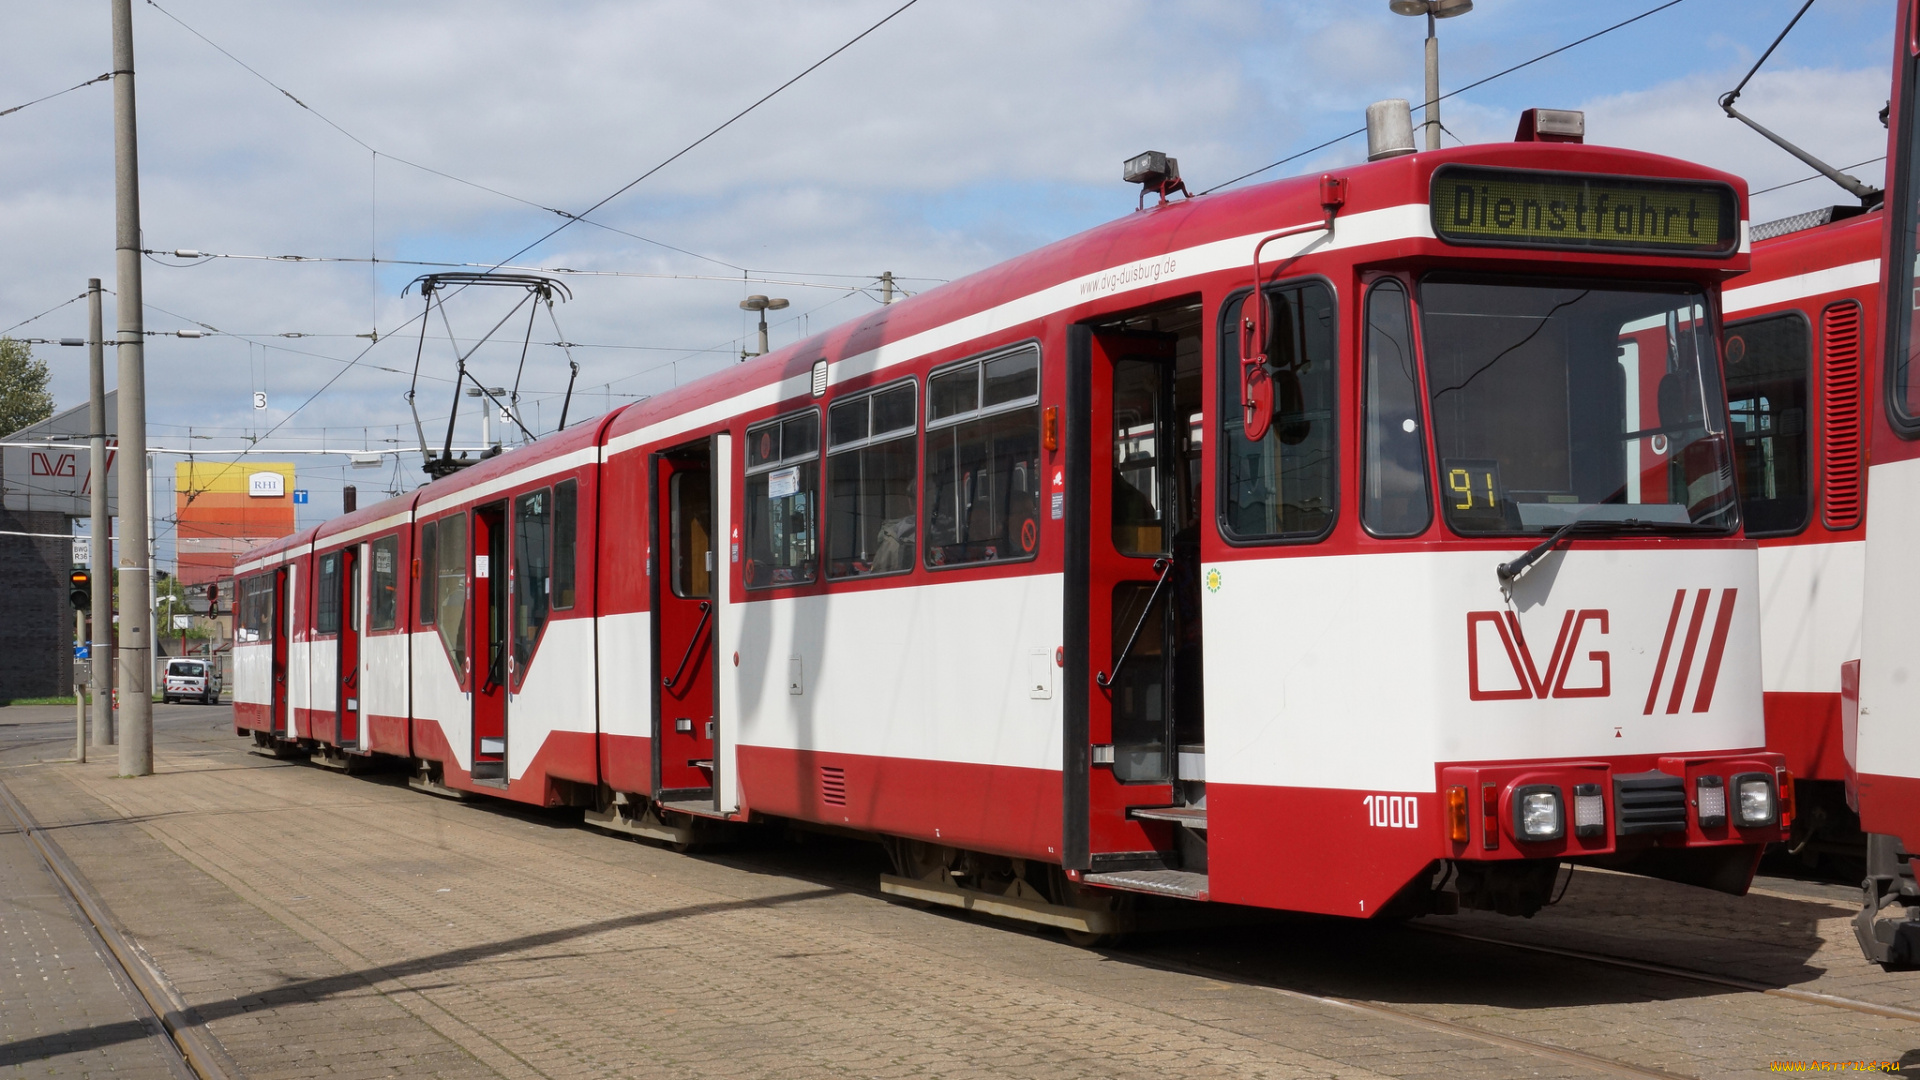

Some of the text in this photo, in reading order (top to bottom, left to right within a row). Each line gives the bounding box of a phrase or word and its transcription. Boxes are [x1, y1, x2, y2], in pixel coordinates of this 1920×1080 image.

[1453, 184, 1700, 238] Dienstfahrt
[1080, 257, 1177, 295] www.dvg-duisburg.de
[255, 393, 266, 409] 3
[501, 407, 511, 422] 4
[31, 452, 75, 477] DVG
[254, 481, 277, 489] RHI
[1449, 469, 1495, 510] 91
[1466, 608, 1612, 702] DVG
[1363, 795, 1419, 829] 1000
[1358, 899, 1365, 912] 1
